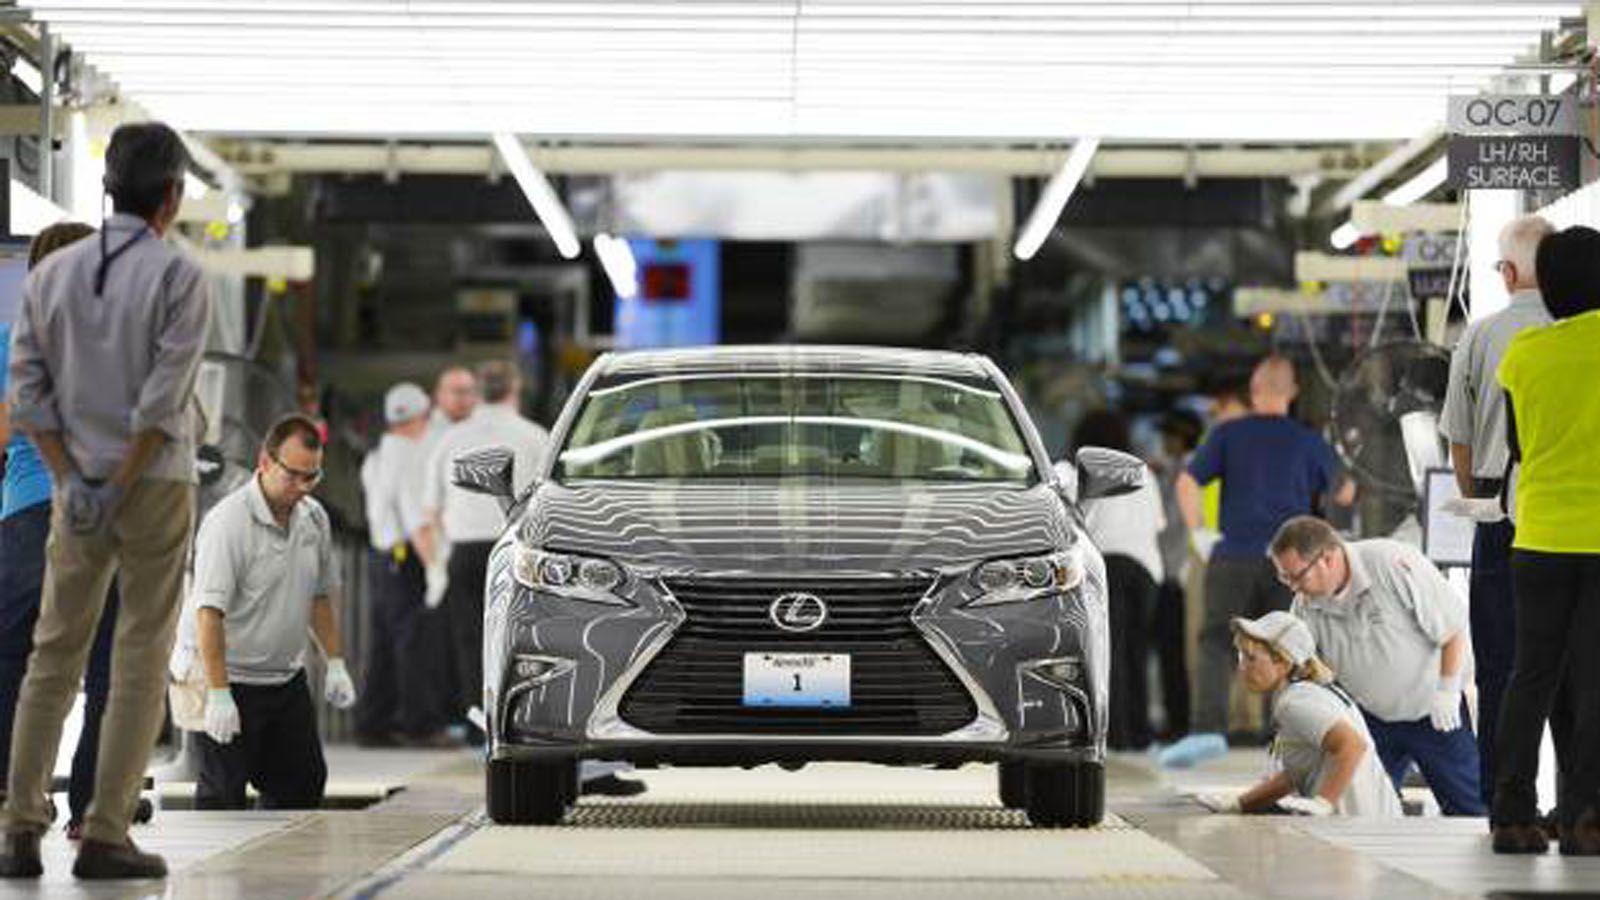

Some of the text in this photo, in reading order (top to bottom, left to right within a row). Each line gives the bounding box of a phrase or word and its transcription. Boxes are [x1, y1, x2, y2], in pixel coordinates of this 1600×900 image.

[1466, 99, 1560, 126] QC-07
[1479, 142, 1547, 162] LH/RH
[1467, 166, 1560, 187] SURFACE
[793, 674, 802, 692] 1
